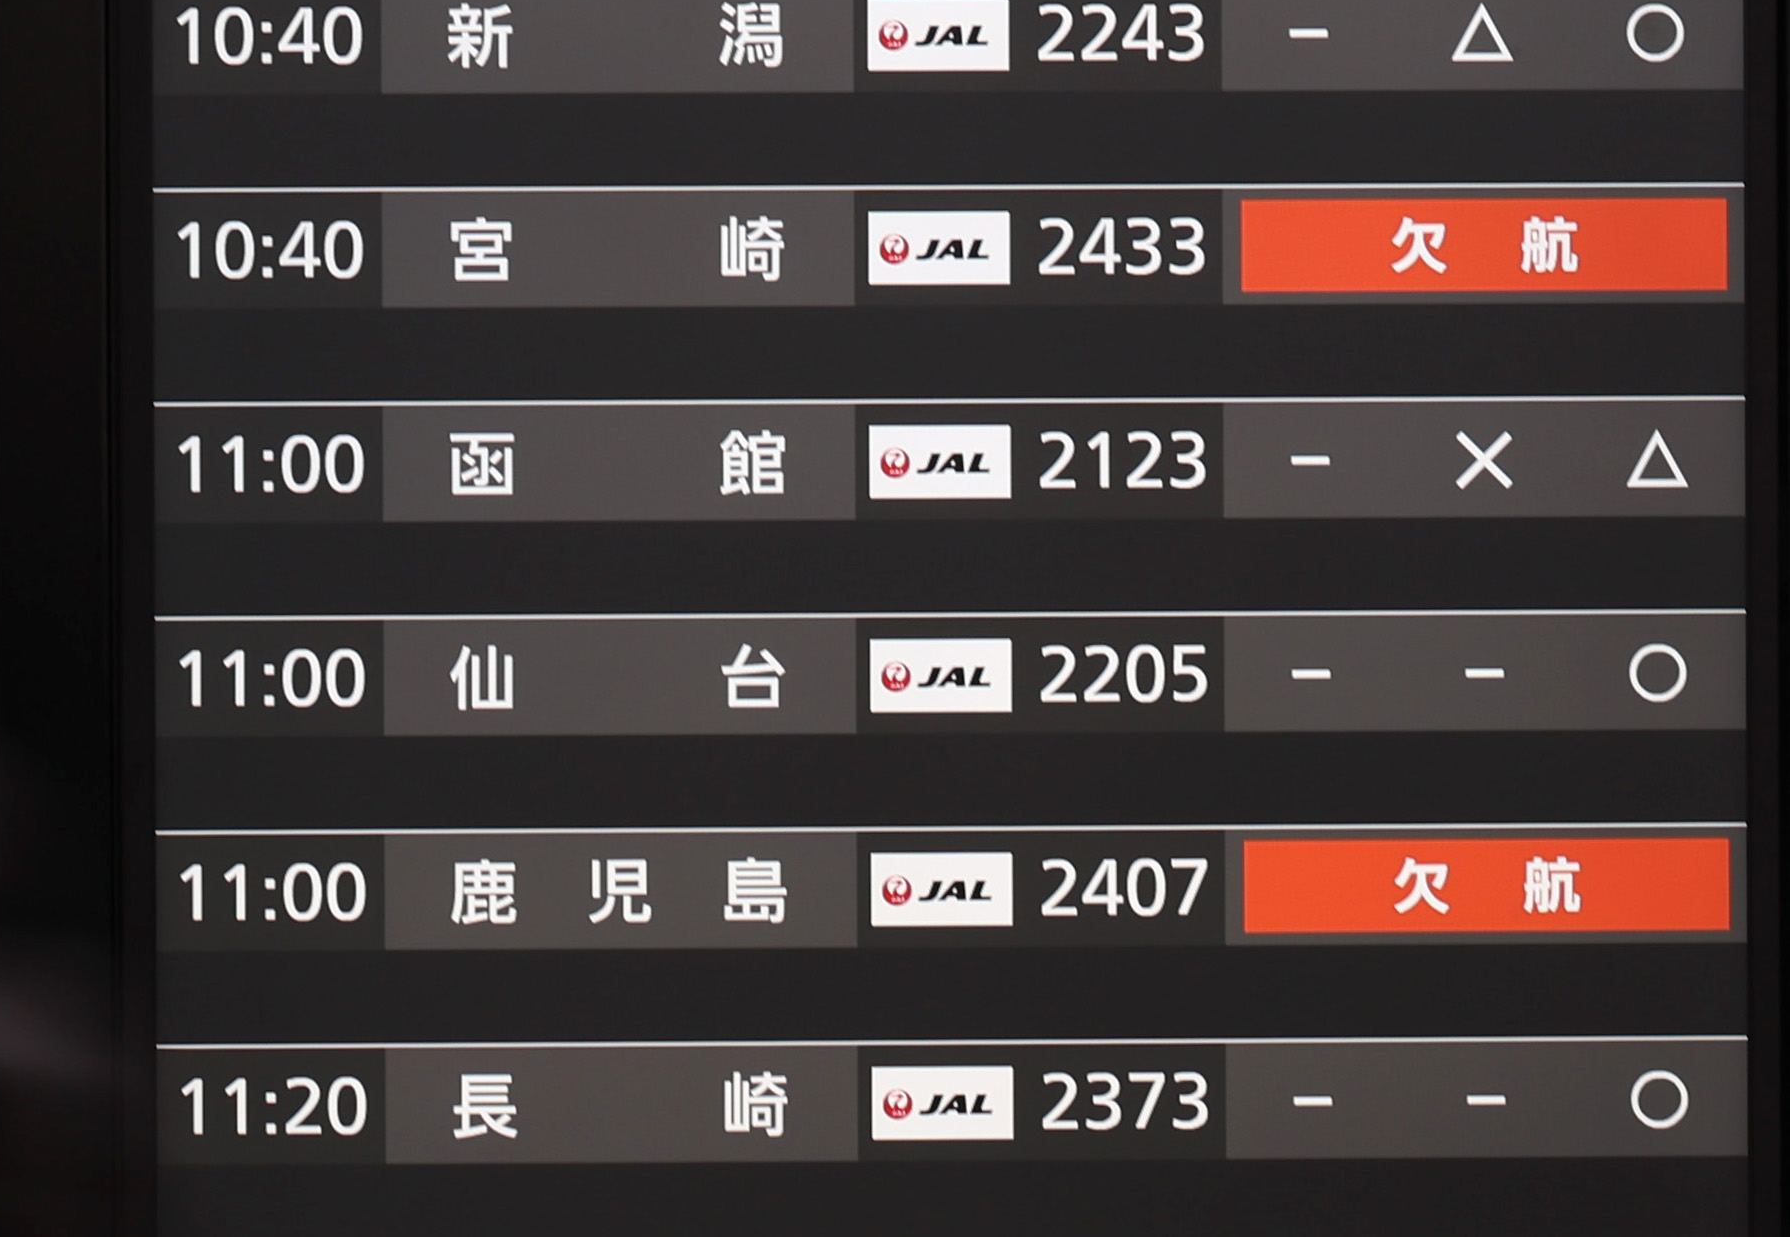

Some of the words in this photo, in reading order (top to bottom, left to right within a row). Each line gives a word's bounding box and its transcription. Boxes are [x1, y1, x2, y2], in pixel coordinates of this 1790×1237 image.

[176, 6, 363, 65] 10:40
[915, 25, 988, 47] JAL
[1037, 3, 1204, 62] 2243
[177, 220, 364, 280] 10:40
[916, 239, 989, 261] JAL
[1038, 217, 1205, 276] 2433
[178, 434, 365, 493] 11:00
[916, 452, 990, 474] JAL
[1039, 430, 1206, 489] 2123
[179, 648, 365, 708] 11:00
[917, 666, 991, 688] JAL
[1040, 644, 1208, 703] 2205
[180, 862, 366, 922] 11:00
[918, 880, 992, 902] JAL
[1041, 857, 1208, 917] 2407
[181, 1076, 367, 1135] 11:20
[919, 1094, 992, 1116] JAL
[1042, 1071, 1209, 1130] 2373
